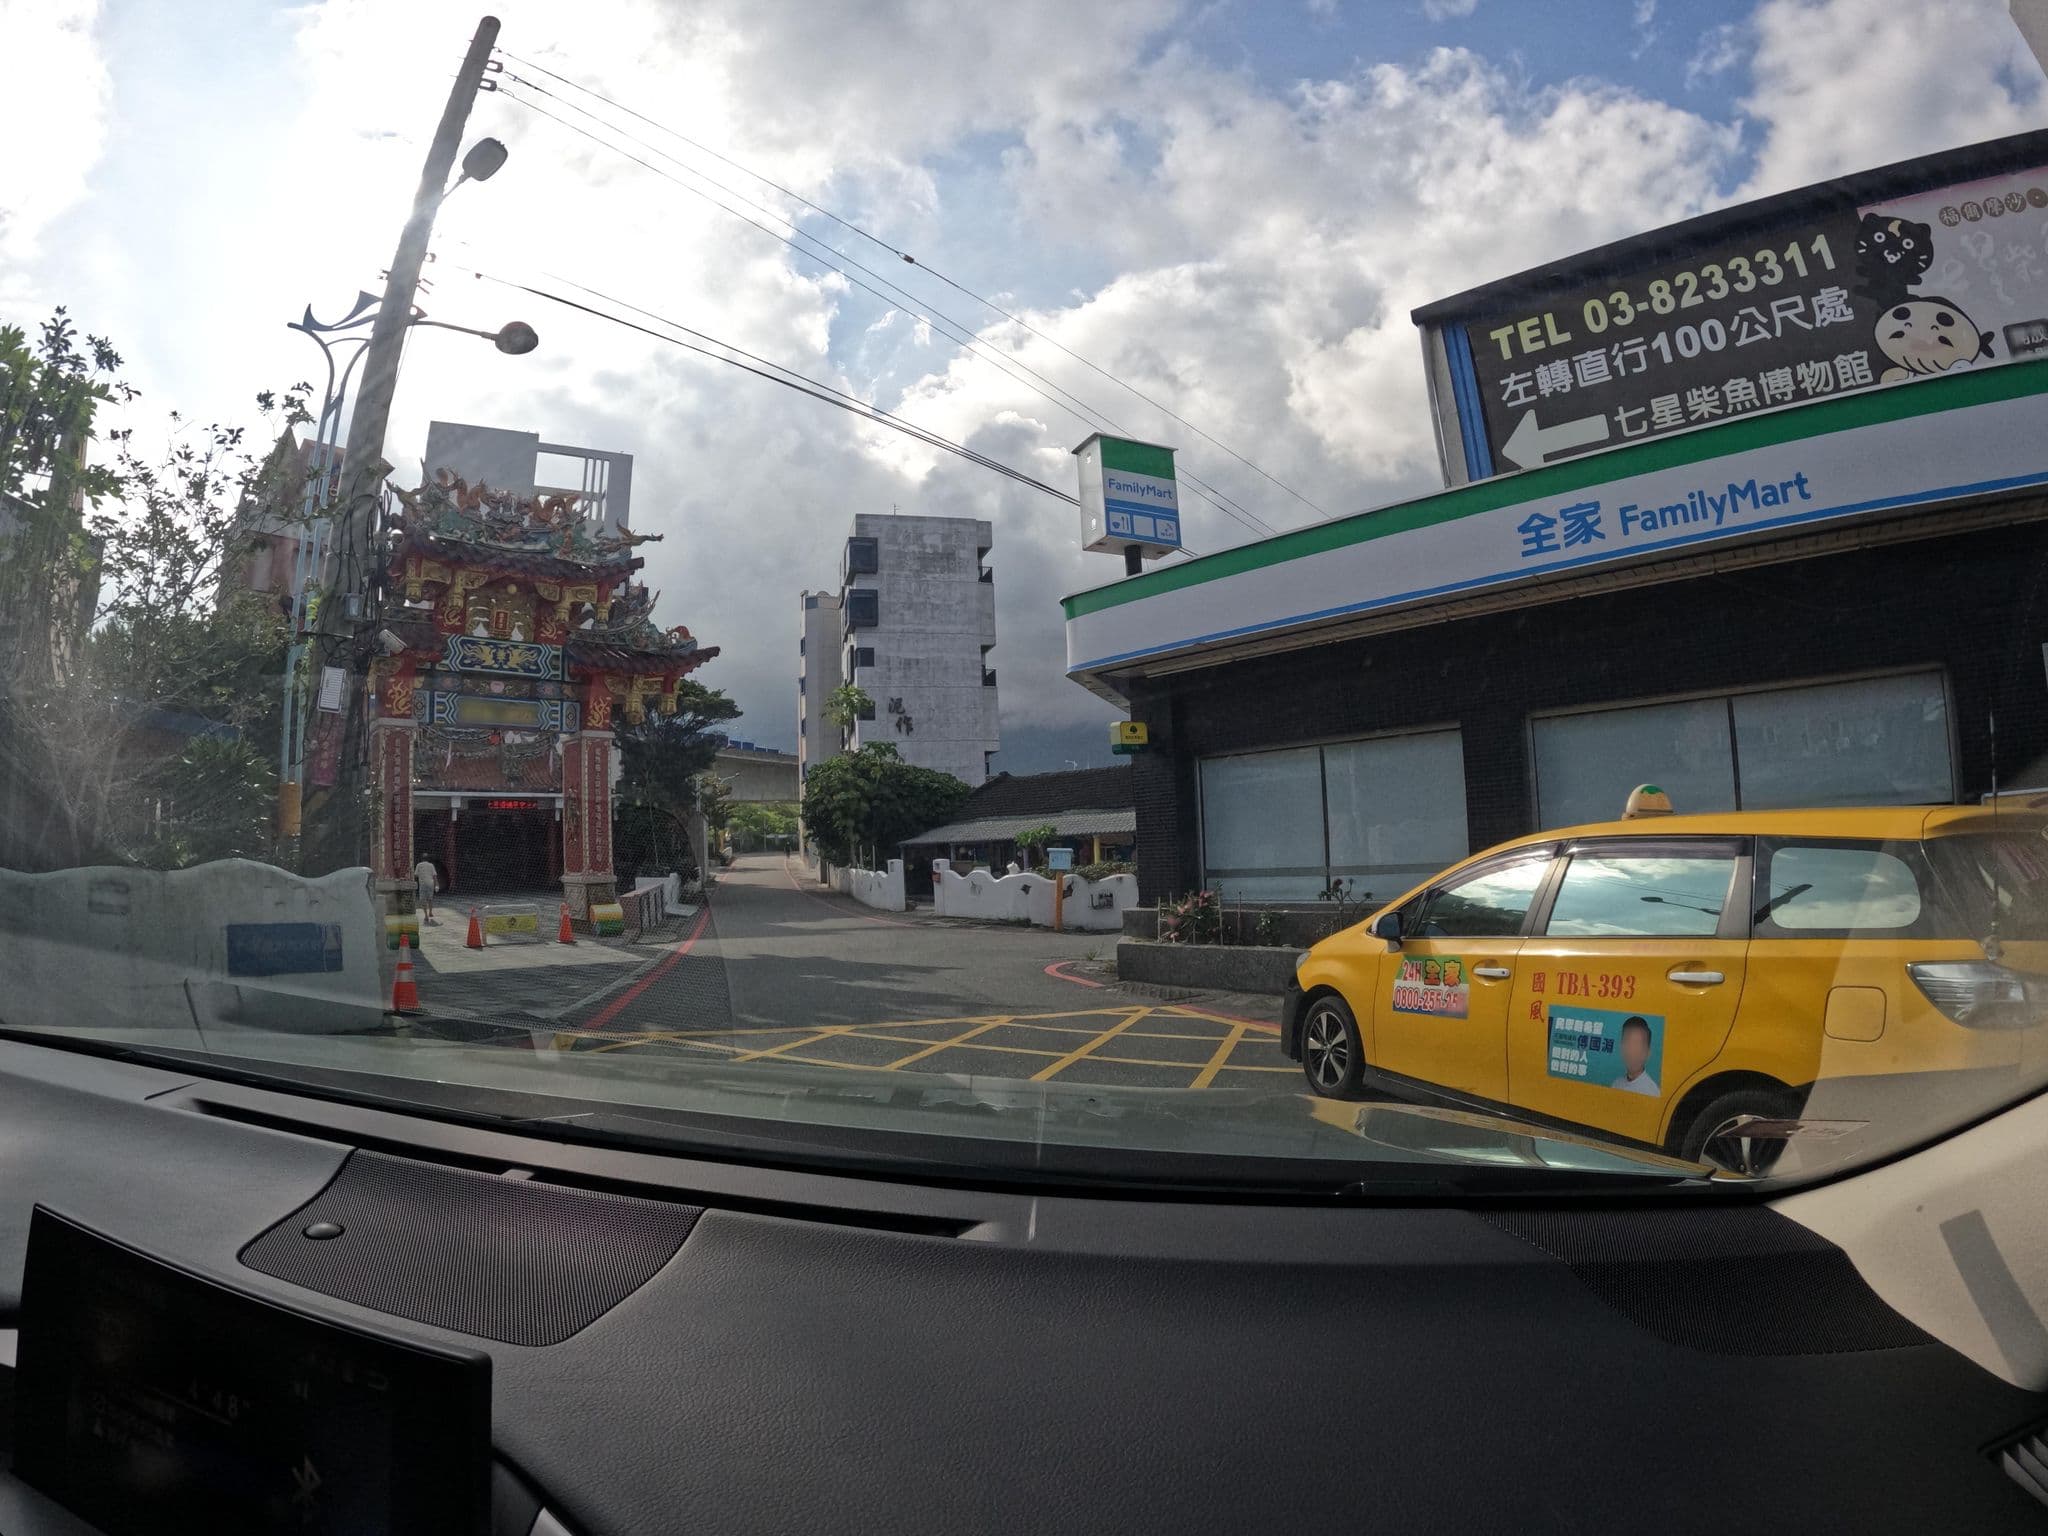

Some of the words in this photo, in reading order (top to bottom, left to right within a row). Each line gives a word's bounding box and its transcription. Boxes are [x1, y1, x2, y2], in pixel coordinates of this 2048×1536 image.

[1489, 312, 1572, 361] TEL
[1583, 234, 1836, 333] 03-8233311
[1500, 286, 1854, 408] 左轉直行100公尺處
[1614, 350, 1874, 437] 七星柴魚博物館
[1108, 478, 1173, 500] FamilyMart
[1517, 500, 1606, 558] 全家
[1619, 472, 1812, 536] FamilyMart
[1402, 960, 1423, 982] 24H
[1424, 959, 1462, 987] 全家
[1557, 972, 1635, 999] TBA-393
